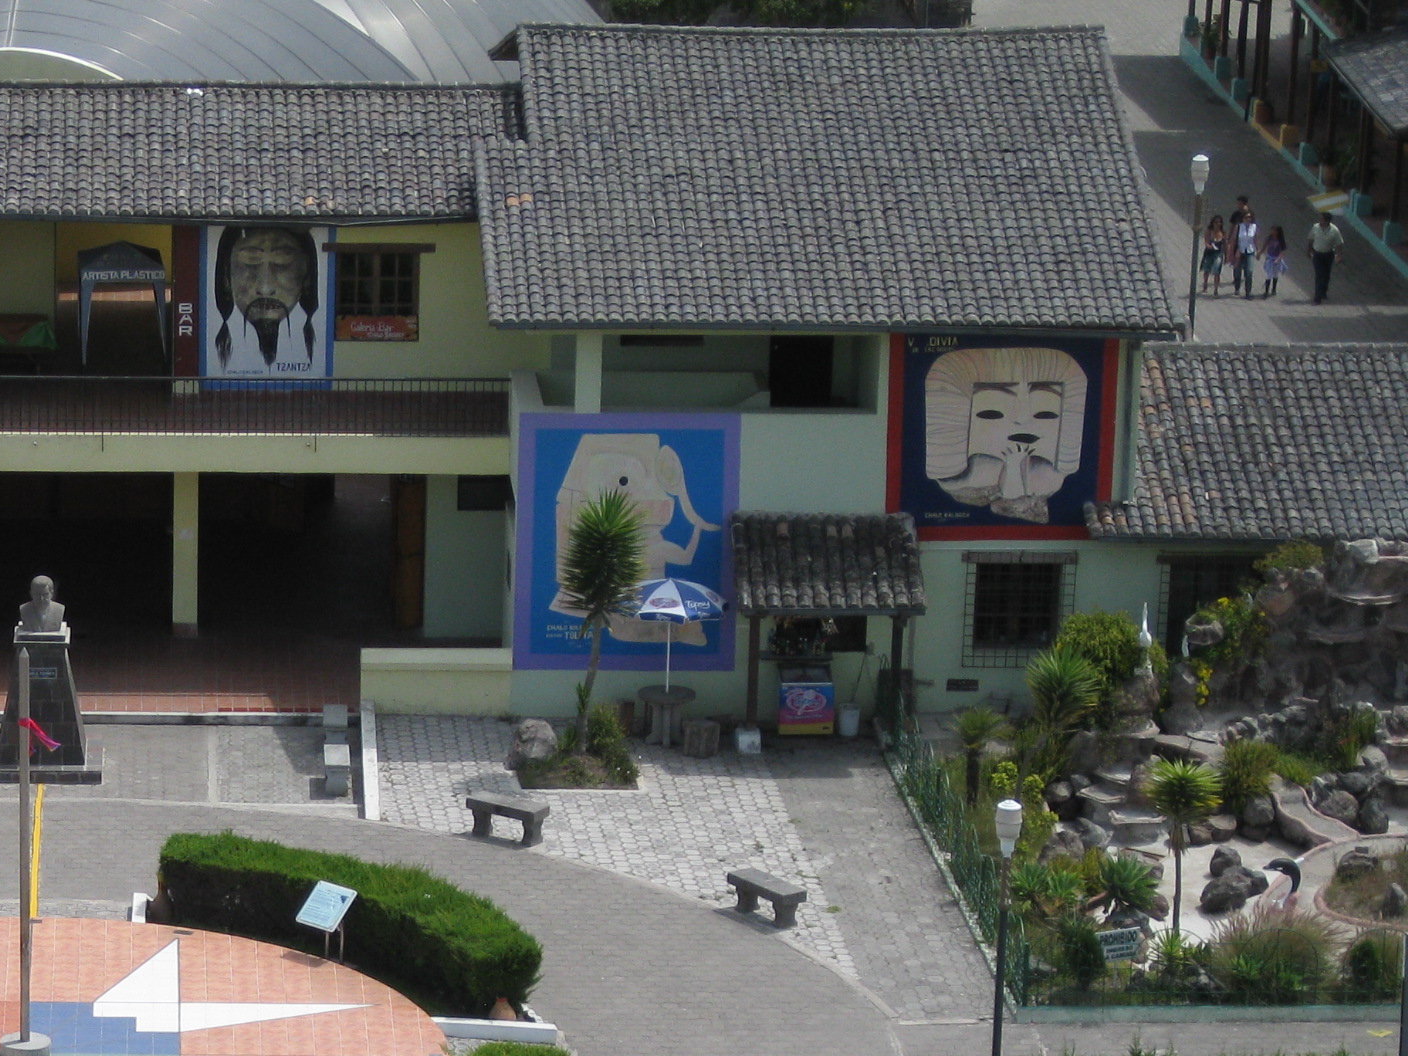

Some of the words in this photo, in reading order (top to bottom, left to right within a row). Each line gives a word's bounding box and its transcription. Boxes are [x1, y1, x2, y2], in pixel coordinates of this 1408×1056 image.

[82, 271, 120, 281] ARTISTA
[121, 270, 165, 280] PLASTICO
[179, 302, 193, 337] BAR
